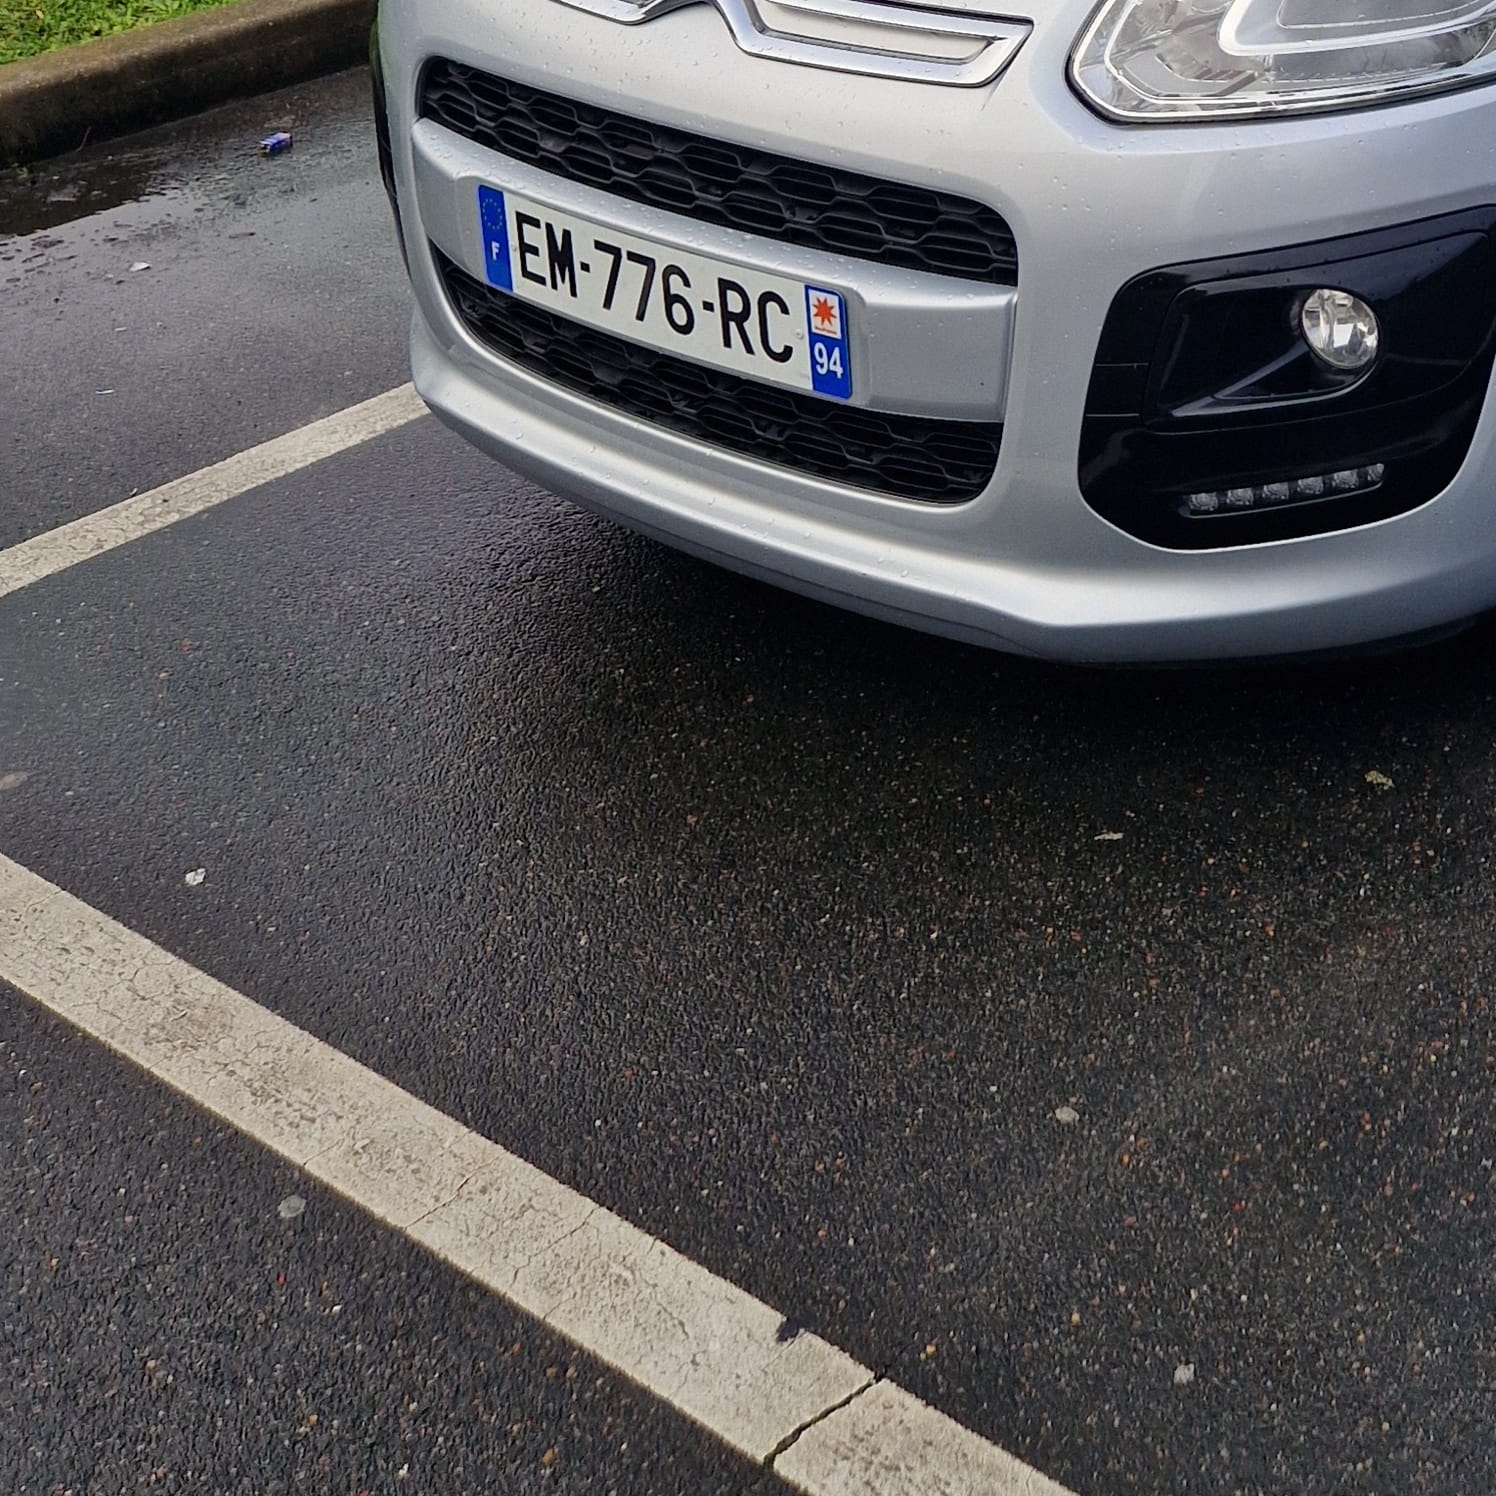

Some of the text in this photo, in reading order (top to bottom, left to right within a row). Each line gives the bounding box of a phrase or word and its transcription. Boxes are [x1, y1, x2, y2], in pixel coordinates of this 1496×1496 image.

[491, 241, 500, 261] F
[515, 210, 794, 363] EM-776-RC
[814, 341, 844, 379] 94
